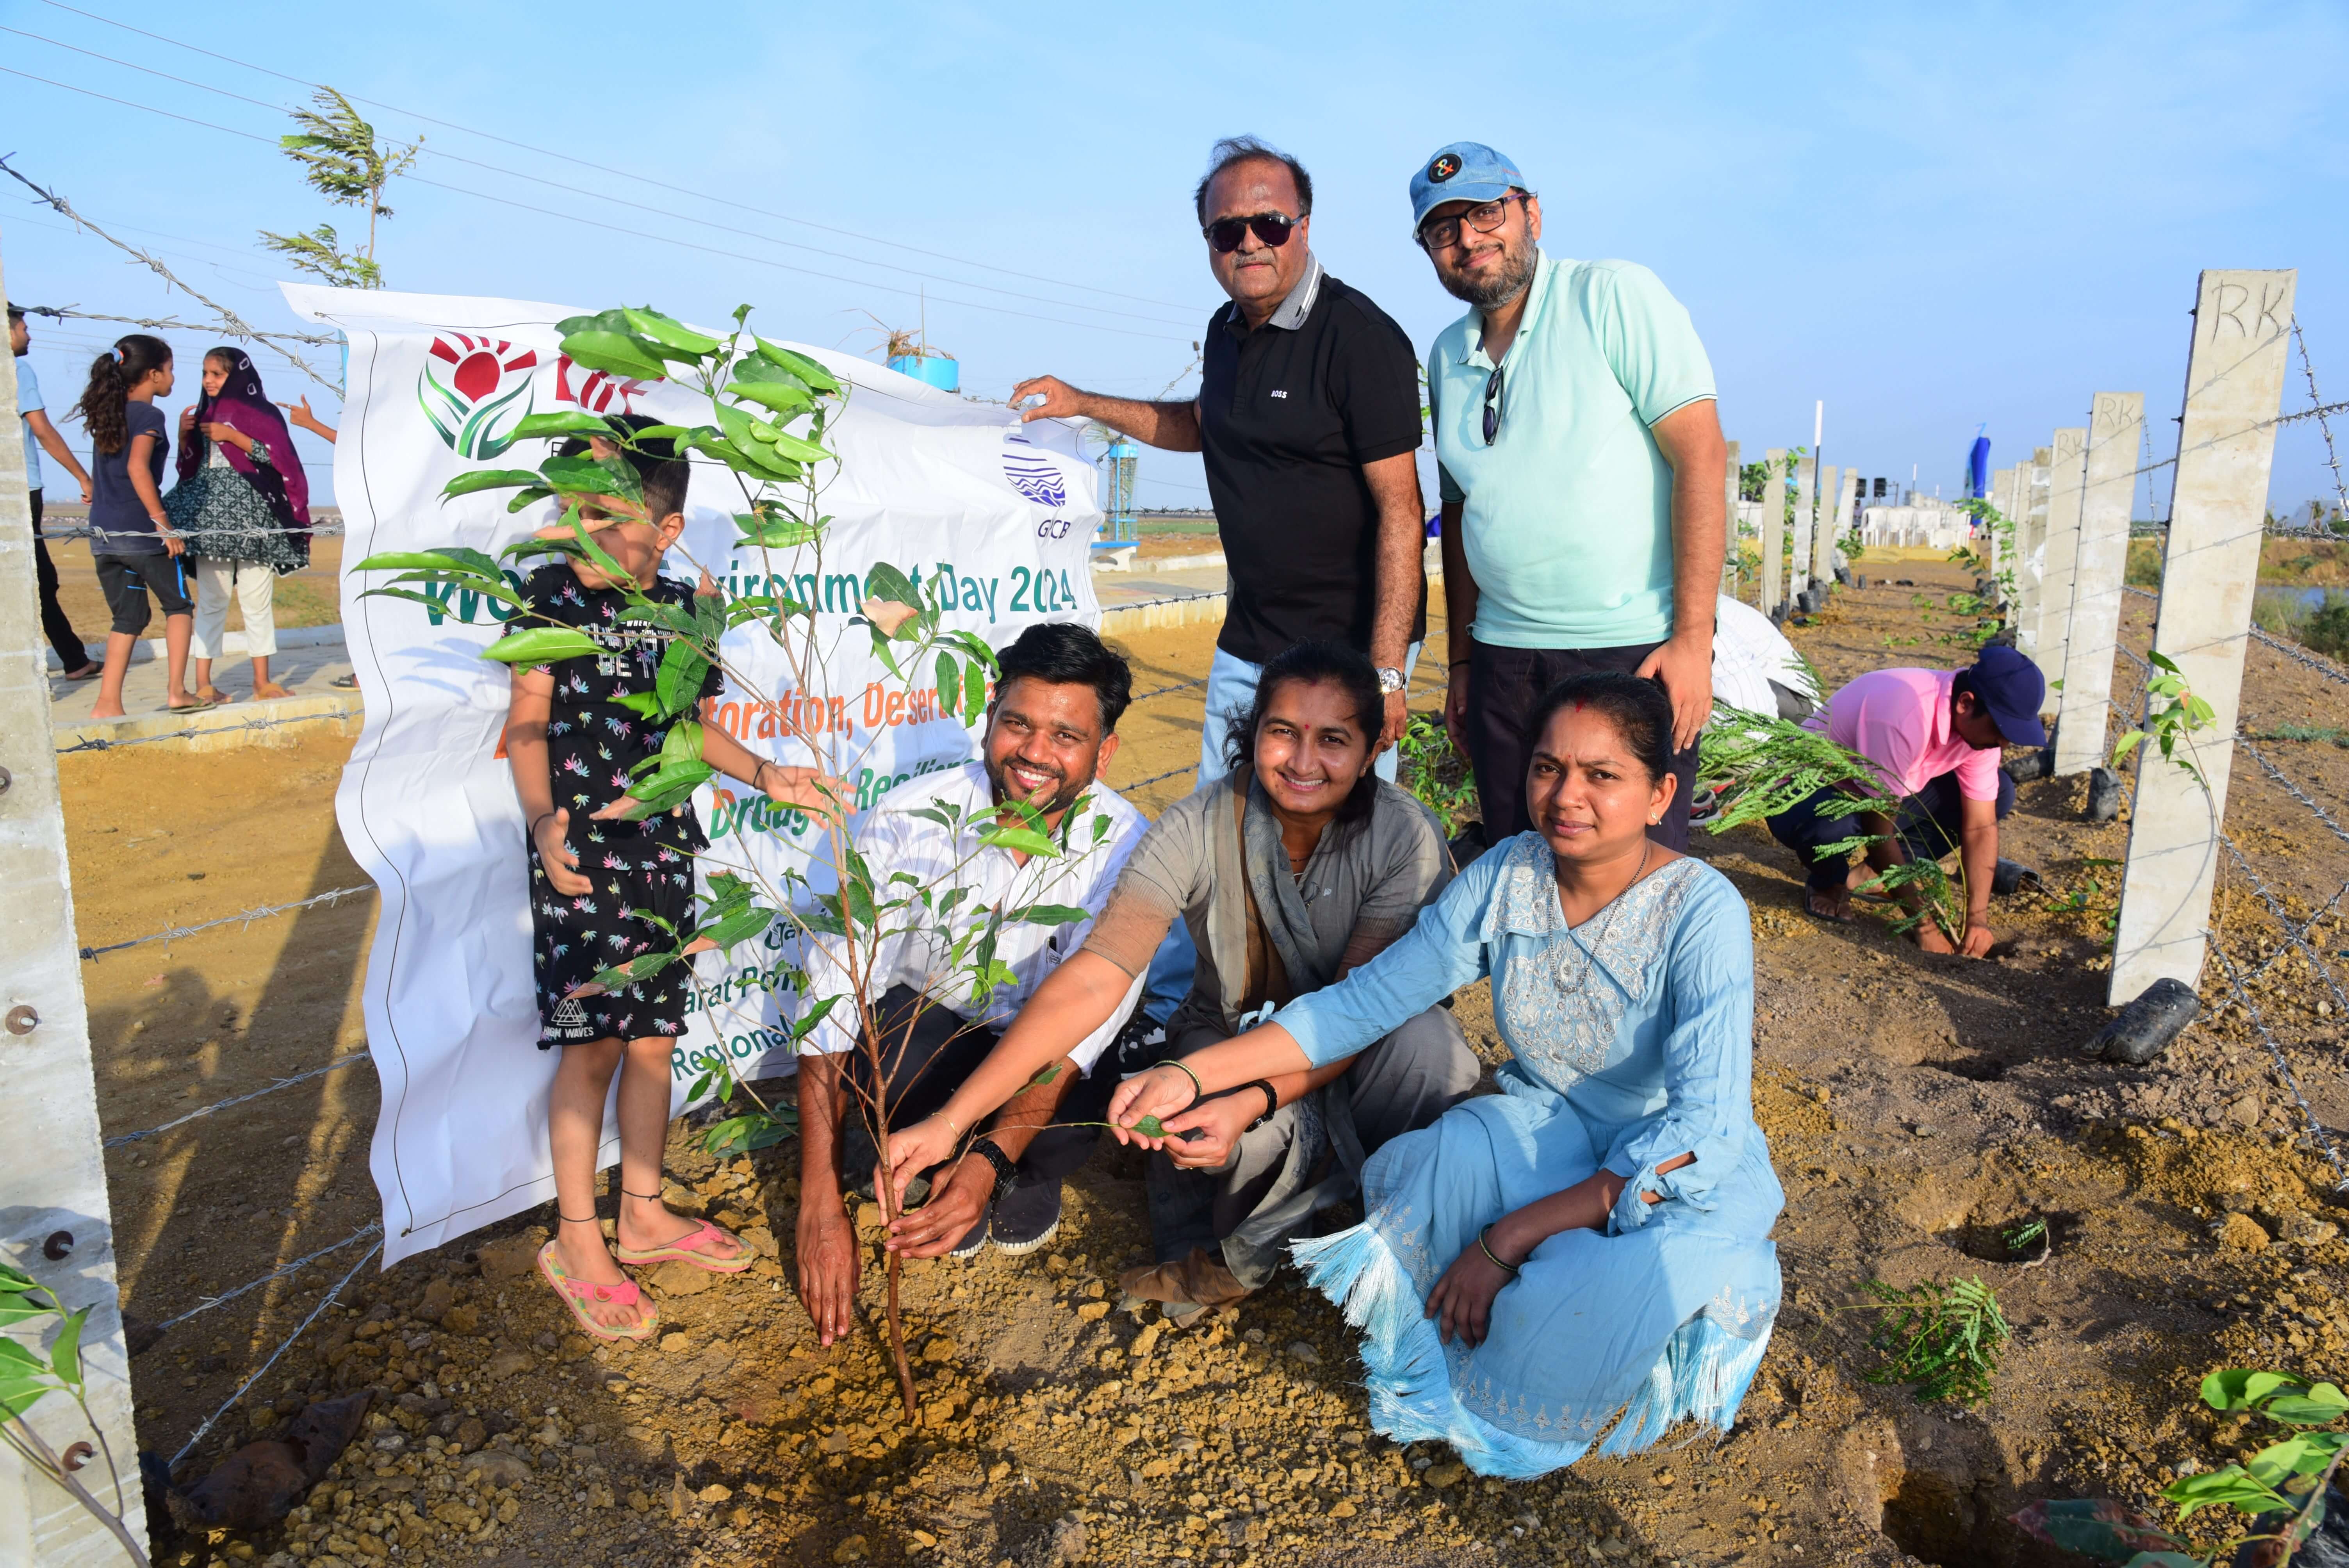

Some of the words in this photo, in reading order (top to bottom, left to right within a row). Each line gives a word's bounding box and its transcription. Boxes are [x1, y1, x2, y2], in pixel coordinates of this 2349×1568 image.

[2211, 279, 2284, 345] RK
[1271, 390, 1287, 399] BOSS
[2096, 397, 2134, 428] RK
[2058, 433, 2085, 460] RK
[1038, 519, 1071, 539] GCB
[936, 562, 999, 624] Day
[1010, 566, 1078, 613] 2024
[683, 974, 732, 1016] arat
[543, 1025, 561, 1038] HIGH
[565, 1026, 594, 1039] WAVES
[671, 1014, 793, 1081] Regional
